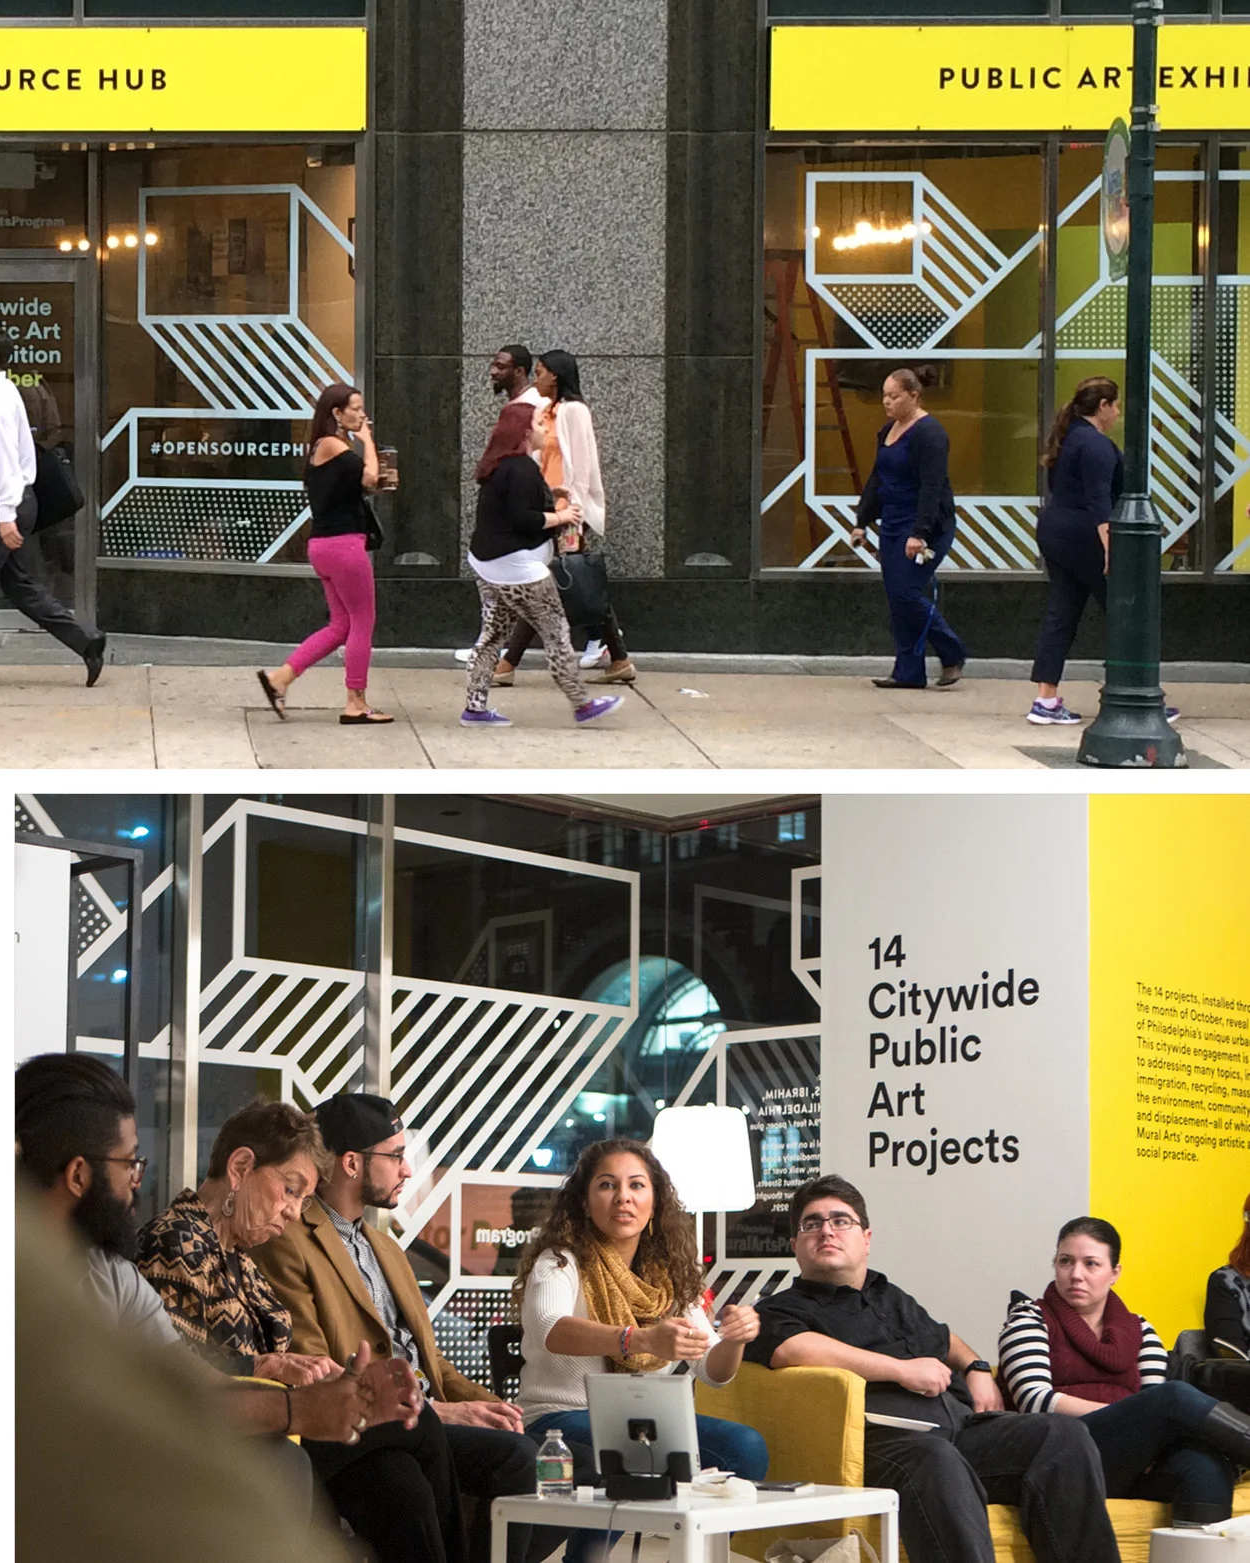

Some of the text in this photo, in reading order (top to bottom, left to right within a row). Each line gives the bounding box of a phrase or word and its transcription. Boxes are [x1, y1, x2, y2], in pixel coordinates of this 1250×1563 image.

[99, 68, 167, 91] HUB
[939, 66, 1250, 90] PUBLIC AR EXHI
[25, 321, 61, 340] Art
[150, 441, 310, 457] #OPENSOURCEPHI
[868, 934, 906, 970] 14
[868, 968, 1040, 1025] Citywide
[1137, 981, 1152, 996] The
[1154, 986, 1163, 997] 14
[1165, 988, 1200, 1005] projects,
[1202, 993, 1235, 1010] installed
[1137, 1001, 1249, 1030] the month of October, reveal
[1137, 1019, 1146, 1030] of
[1147, 1020, 1202, 1040] Philadelphia's
[1204, 1030, 1231, 1045] unique
[869, 1024, 982, 1069] Public
[1137, 1036, 1249, 1064] This citywide engagement is
[1137, 1056, 1243, 1082] to addressing many topics,
[1137, 1072, 1250, 1099] immigration, recycling, mass
[867, 1081, 926, 1118] Art
[1137, 1092, 1150, 1104] the
[1152, 1095, 1206, 1111] environment,
[1137, 1110, 1152, 1122] and
[1224, 1119, 1232, 1131] of
[869, 1127, 1020, 1176] Projects
[1137, 1127, 1161, 1141] Mural
[1184, 1134, 1217, 1149] ongoing
[1218, 1136, 1245, 1151] artistic
[1137, 1146, 1199, 1162] social practice.
